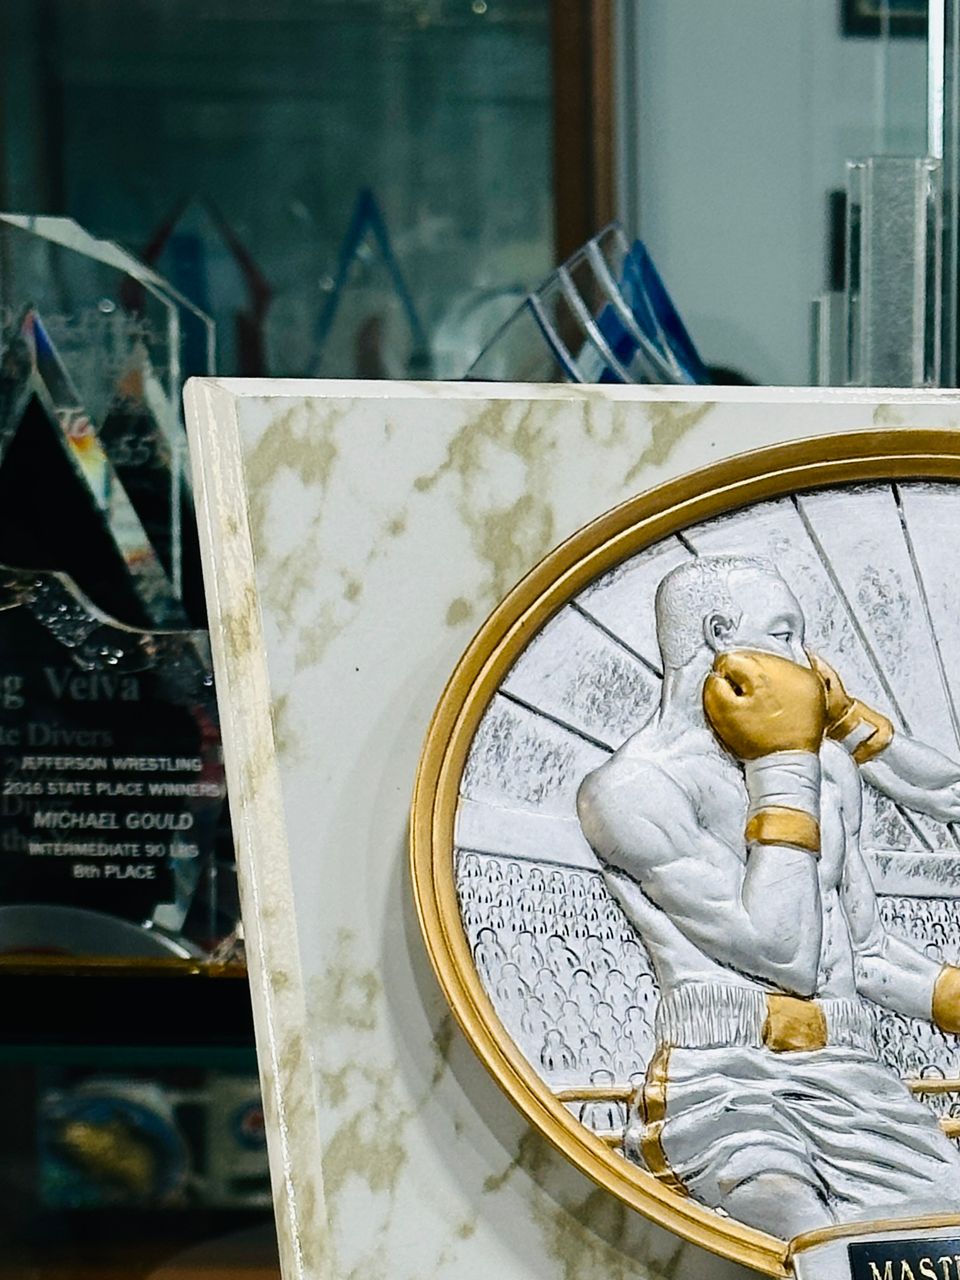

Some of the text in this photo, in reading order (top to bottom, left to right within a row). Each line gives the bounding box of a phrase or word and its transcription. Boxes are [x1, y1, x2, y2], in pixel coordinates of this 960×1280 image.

[21, 757, 108, 771] JEFFERSON
[113, 757, 203, 772] WRESTLING
[47, 782, 92, 796] STATE
[96, 782, 145, 797] PLACE
[149, 783, 222, 798] WINNERS
[34, 811, 193, 831] MICHAEL GOULD
[28, 843, 141, 857] INTERMEDIATE
[145, 844, 166, 857] 90
[73, 865, 156, 880] 8th PLACE
